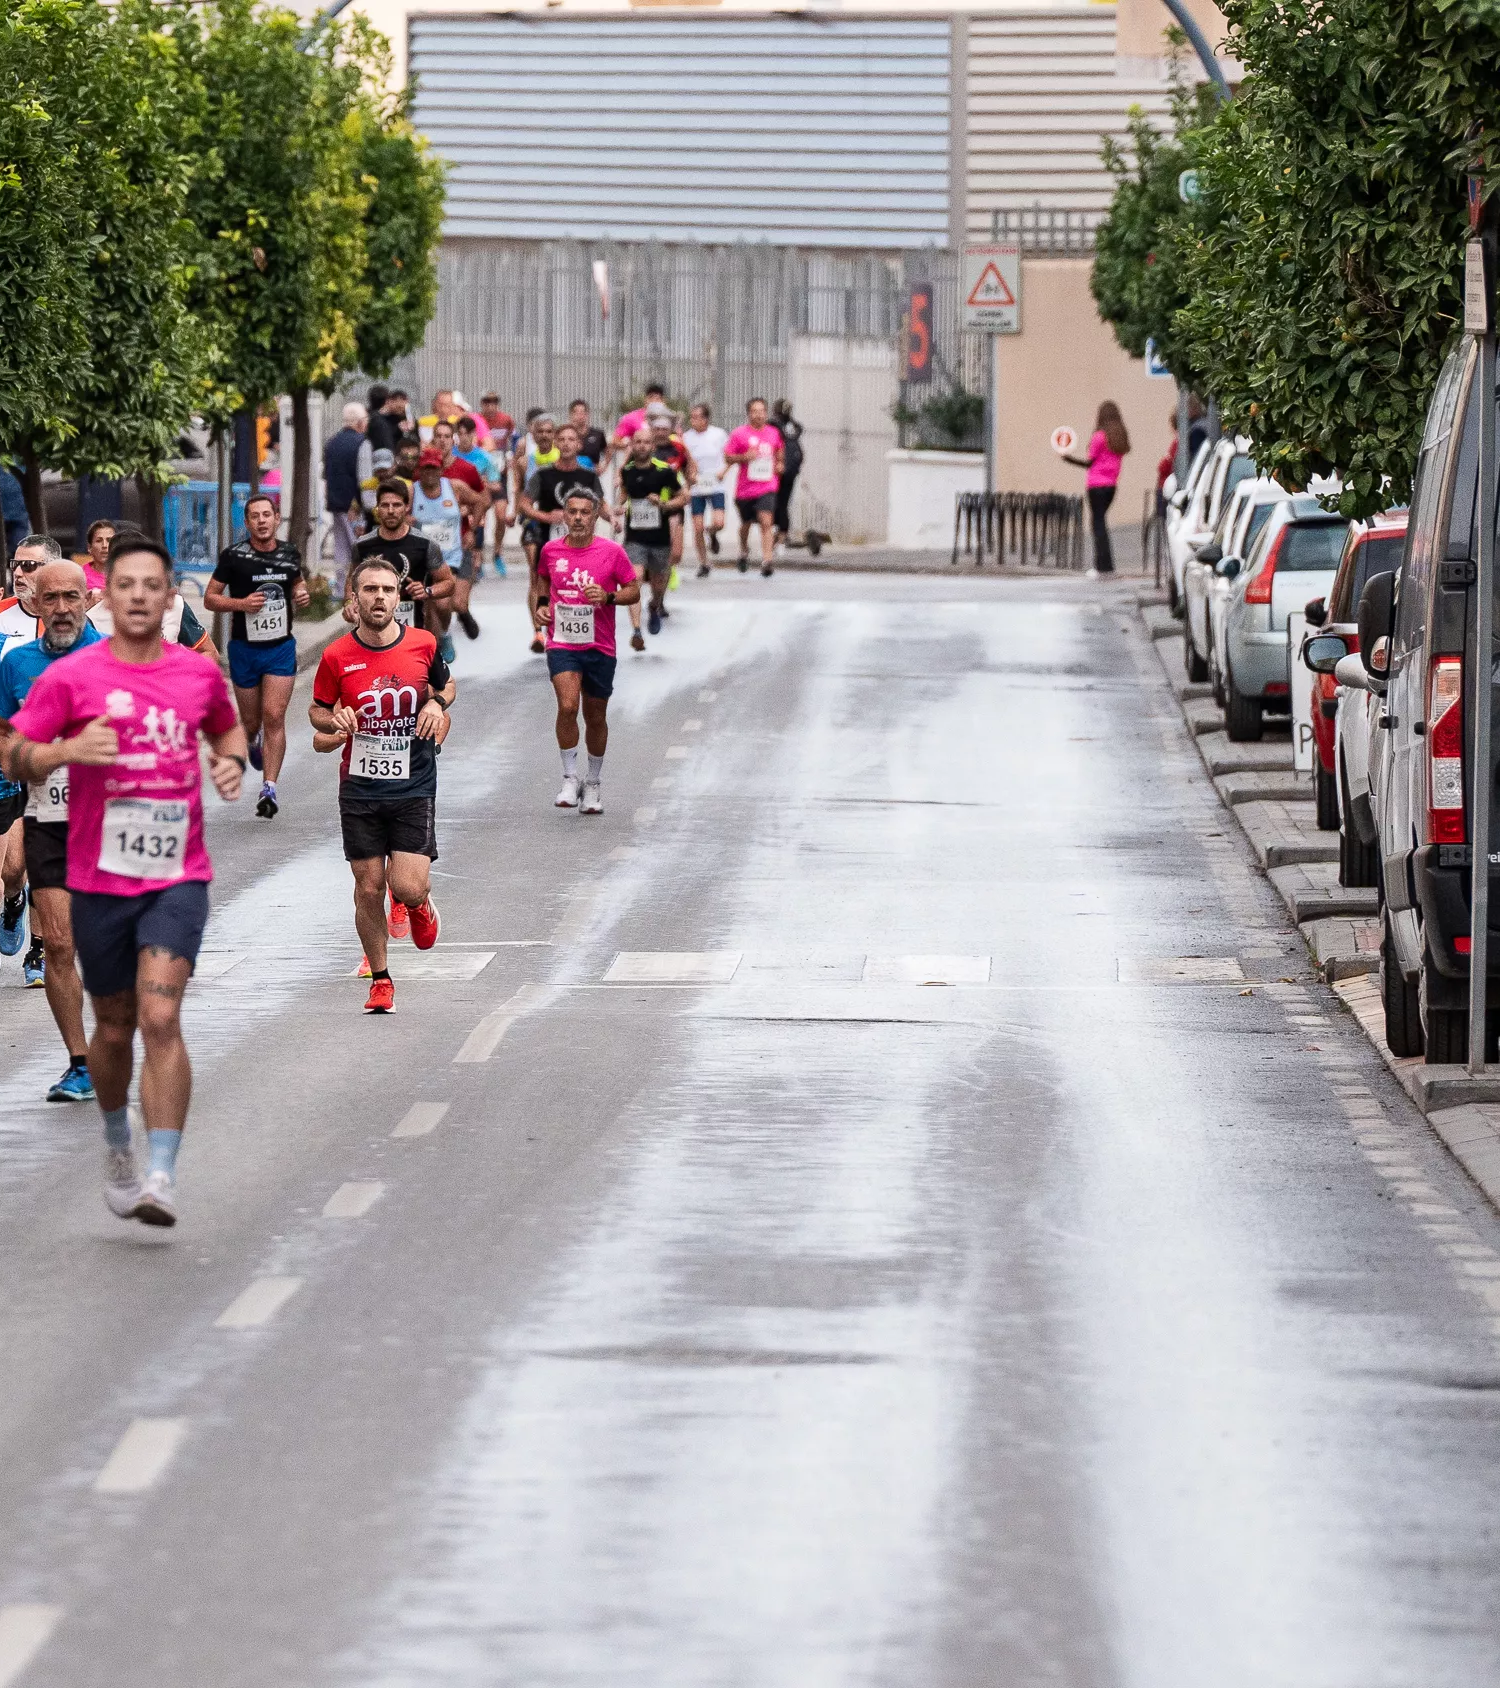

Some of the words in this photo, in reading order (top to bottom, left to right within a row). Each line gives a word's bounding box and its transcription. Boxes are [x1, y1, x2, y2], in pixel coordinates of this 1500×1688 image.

[253, 616, 282, 632] 1451
[560, 621, 589, 634] 1436
[357, 685, 418, 719] am
[360, 716, 416, 730] albayate
[359, 757, 402, 776] 1535
[117, 830, 178, 859] 1432
